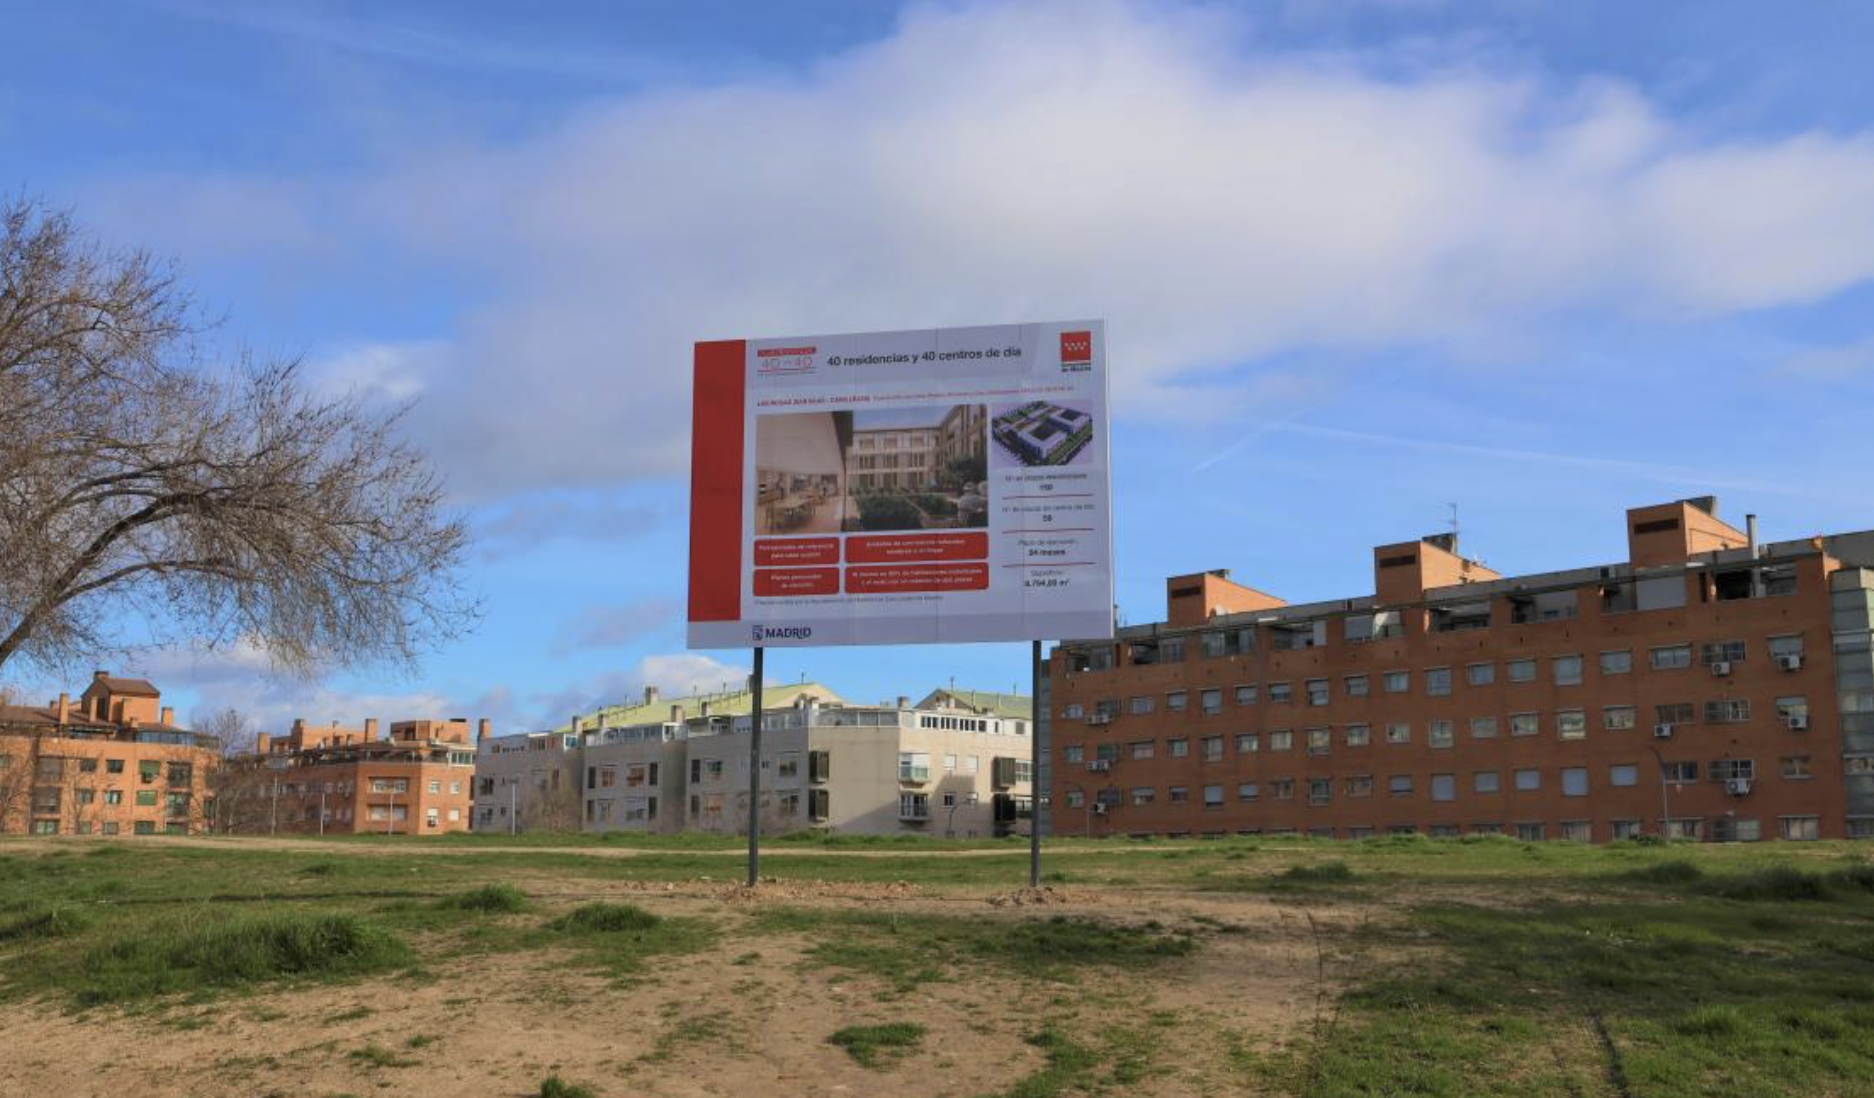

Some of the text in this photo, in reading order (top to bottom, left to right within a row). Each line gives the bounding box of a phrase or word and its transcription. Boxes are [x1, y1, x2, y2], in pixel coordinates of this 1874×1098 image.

[827, 356, 841, 367] 40
[843, 352, 910, 367] residencias
[911, 354, 919, 364] y
[921, 350, 936, 361] 40
[938, 349, 983, 361] centros
[985, 346, 1001, 359] de
[764, 626, 812, 640] MADRID
